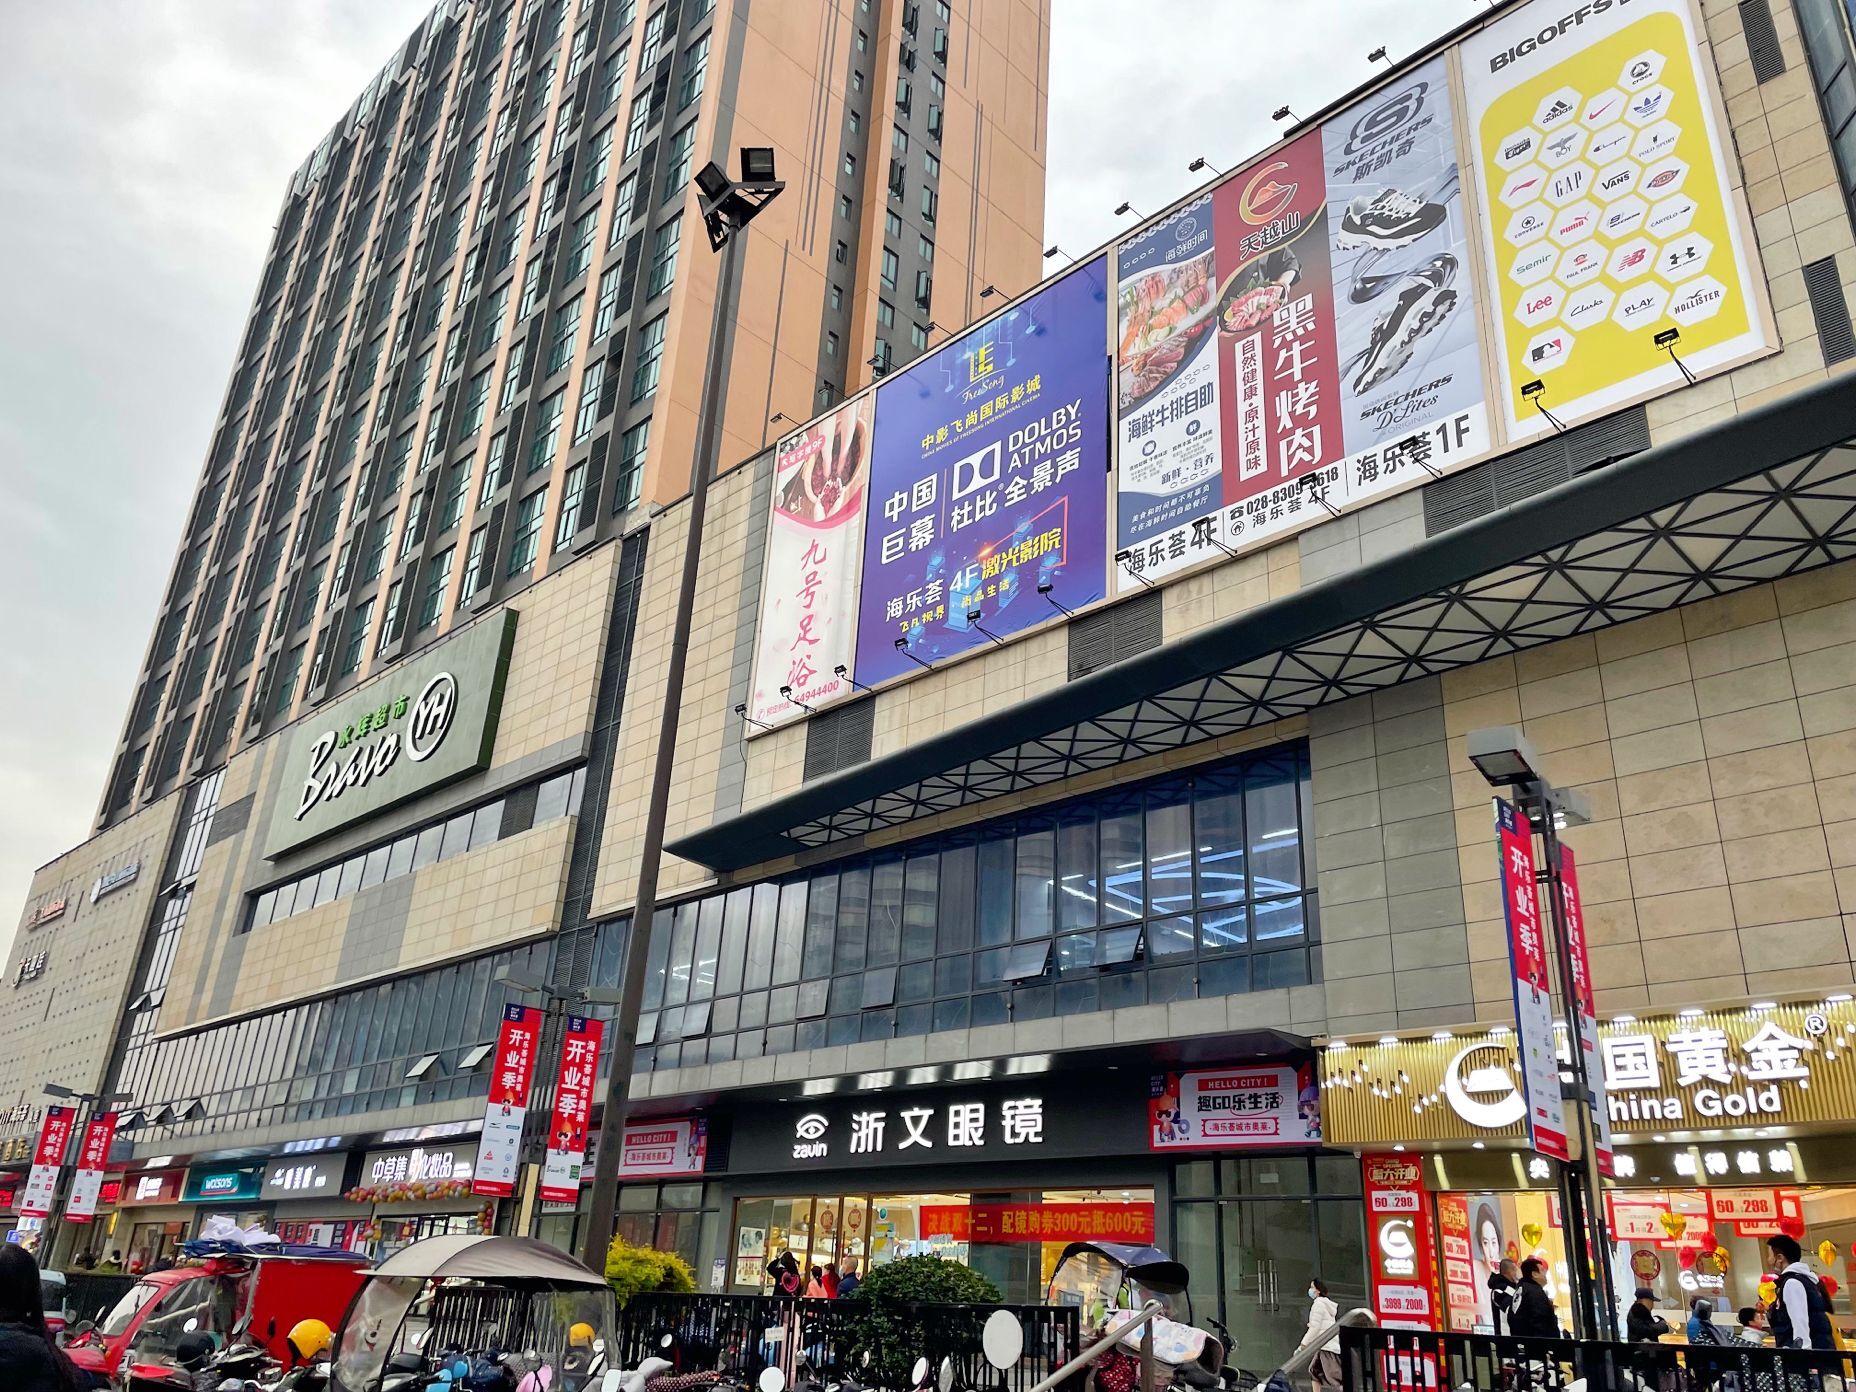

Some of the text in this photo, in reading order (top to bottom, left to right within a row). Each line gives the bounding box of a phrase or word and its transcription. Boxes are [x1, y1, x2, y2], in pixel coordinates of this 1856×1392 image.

[1490, 0, 1613, 73] BIGOFFS
[1632, 72, 1653, 85] crocs
[1542, 104, 1573, 124] adidas
[1332, 113, 1434, 178] SKECHERS
[1352, 136, 1416, 183] 斯凯奇
[1556, 145, 1572, 158] BOY
[1555, 171, 1582, 198] GAP
[1601, 170, 1630, 190] VANS
[1240, 211, 1300, 261] 天越山
[1526, 295, 1552, 315] Lee
[1624, 297, 1654, 314] PLAY
[1674, 290, 1720, 314] HOLLISTER
[1272, 293, 1322, 477] 黑牛烤肉
[1360, 373, 1453, 421] SKECHERS
[921, 373, 1041, 450] 中影飞尚国际影城
[1008, 398, 1081, 453] DOLBY
[1127, 381, 1214, 443] 海鲜牛排自助
[1387, 411, 1434, 434] ORIGINAL
[1007, 420, 1081, 474] ATMOS
[884, 473, 938, 523] 中国
[881, 513, 936, 565] 巨幕
[786, 538, 828, 688] 九号足浴
[899, 604, 945, 633] 飞凡视界
[338, 693, 411, 749] 永辉超市
[293, 730, 401, 820] Bravo
[1510, 845, 1534, 956] 开业季
[501, 1028, 524, 1090] 开业季
[558, 1039, 586, 1118] 开业季
[1556, 1022, 1810, 1090] 国黄金
[1208, 1079, 1238, 1089] HELLO
[1606, 1085, 1782, 1121] hina Gold
[631, 1134, 651, 1144] HELLO
[850, 1098, 1043, 1154] 浙文眼镜
[371, 1155, 408, 1184] 中草集
[793, 1141, 828, 1159] zavin
[204, 1177, 233, 1190] watsons
[1375, 1197, 1387, 1207] 60
[1716, 1199, 1768, 1213] 60 298
